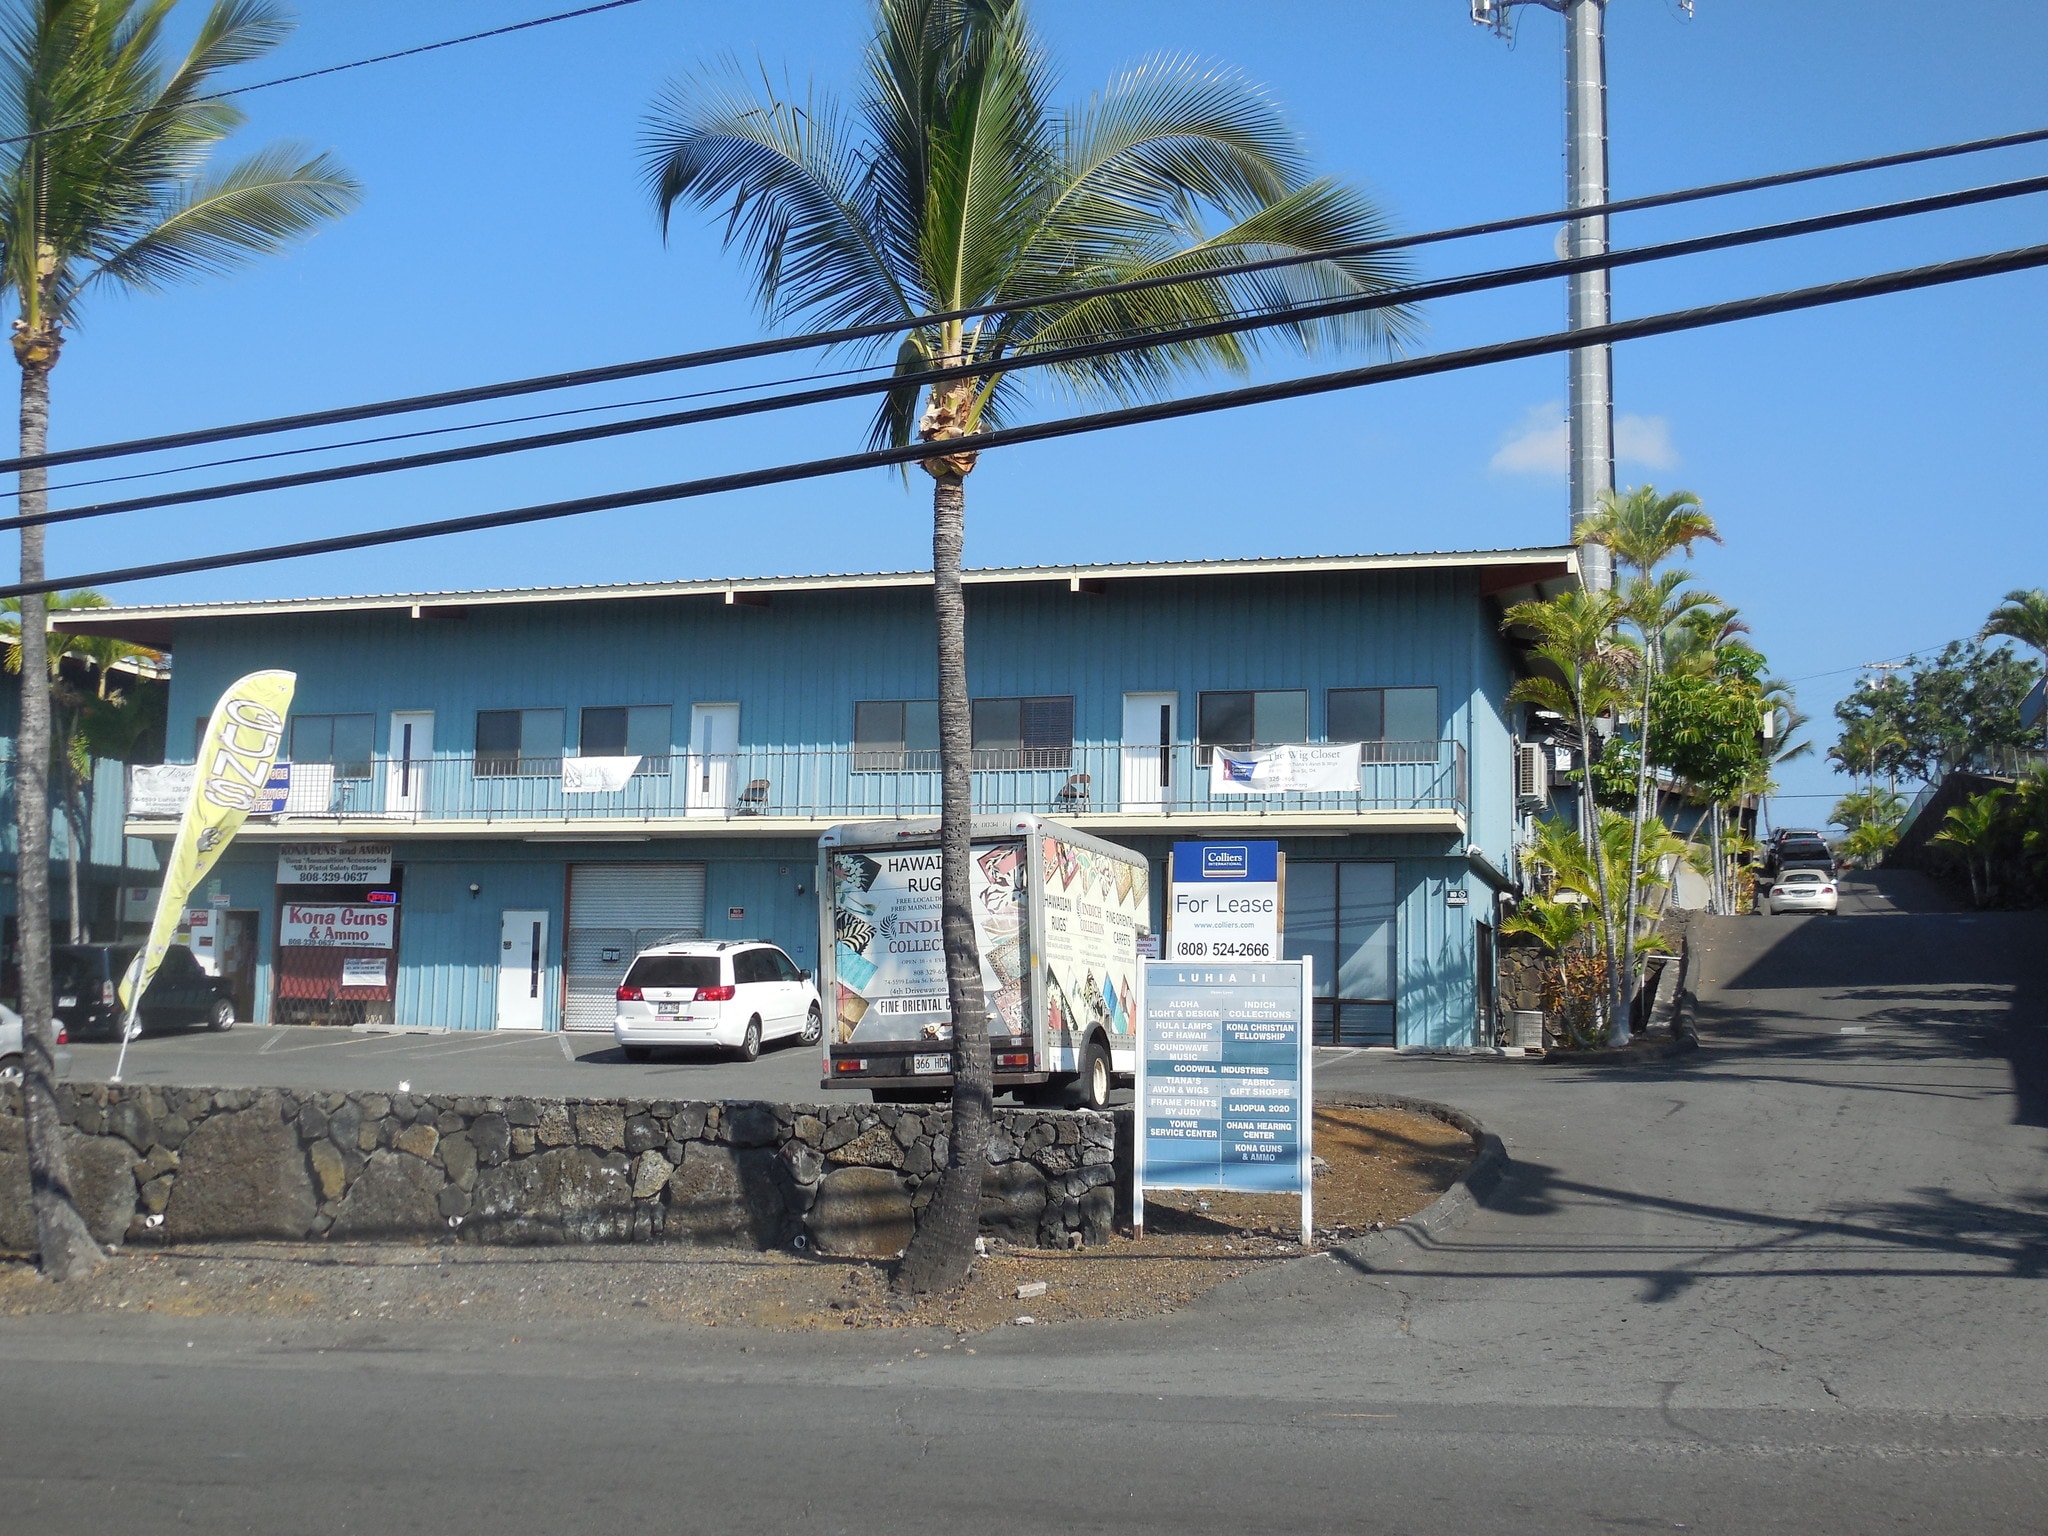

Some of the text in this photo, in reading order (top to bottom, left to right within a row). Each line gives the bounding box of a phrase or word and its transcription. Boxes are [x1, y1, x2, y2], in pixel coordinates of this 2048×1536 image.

[204, 699, 283, 811] GUNS
[1288, 750, 1309, 762] Wig
[1311, 749, 1341, 760] Closet
[270, 768, 288, 779] ORE
[254, 800, 273, 811] TER
[340, 846, 357, 855] and
[1207, 852, 1243, 863] Colliers
[888, 856, 943, 873] HAWAI
[299, 872, 368, 882] 808-339-0637
[908, 877, 942, 893] RUG
[368, 893, 393, 902] OPEN
[891, 903, 942, 912] FREE MAINLAND
[1176, 894, 1274, 913] For Lease
[289, 906, 388, 926] Kona Guns
[898, 920, 940, 934] INDI
[1051, 915, 1067, 932] RUGS
[1194, 921, 1255, 930] www.colliers.com
[309, 926, 369, 941] & Ammo
[889, 939, 944, 953] COLLEC
[1177, 941, 1270, 957] (808) 524-2666
[926, 968, 946, 976] 329-65
[1178, 973, 1266, 983] LUHIA II
[905, 987, 936, 995] Driveway
[880, 1000, 899, 1013] FINE
[902, 998, 942, 1012] ORIENTAL
[1169, 1001, 1199, 1009] ALOHA
[1244, 1001, 1276, 1009] INDICH
[1150, 1010, 1220, 1018] LIGHT & DESIGN
[1229, 1011, 1292, 1019] COLLECTIONS
[1155, 1022, 1213, 1030] HULA LAMPS
[1226, 1023, 1294, 1032] KONA CHRISTIAN
[1162, 1032, 1207, 1040] OF HAWAII
[1234, 1033, 1286, 1041] FELLOWSHIP
[1153, 1044, 1209, 1052] SOUNDWAVE
[1169, 1053, 1198, 1061] MUSIC
[915, 1058, 930, 1069] 366
[1174, 1065, 1270, 1075] GOODWILL INDUSTRIES
[1166, 1077, 1202, 1085] TIANA'S
[1242, 1079, 1276, 1087] FABRIC
[1152, 1086, 1209, 1094] AVON & WIGS
[1230, 1088, 1290, 1096] GIFT SHOPPE
[1151, 1098, 1217, 1107] FRAME PRINTS
[1165, 1108, 1201, 1116] BY JUDY
[1268, 1105, 1290, 1113] 2020
[1169, 1120, 1198, 1129] YOKWE
[1226, 1122, 1292, 1131] OHANA HEARING
[1150, 1129, 1218, 1138] SERVICE CENTER
[1243, 1131, 1275, 1140] CENTER
[1235, 1144, 1283, 1153] KONA GUNS
[1241, 1153, 1276, 1162] & AMMO
